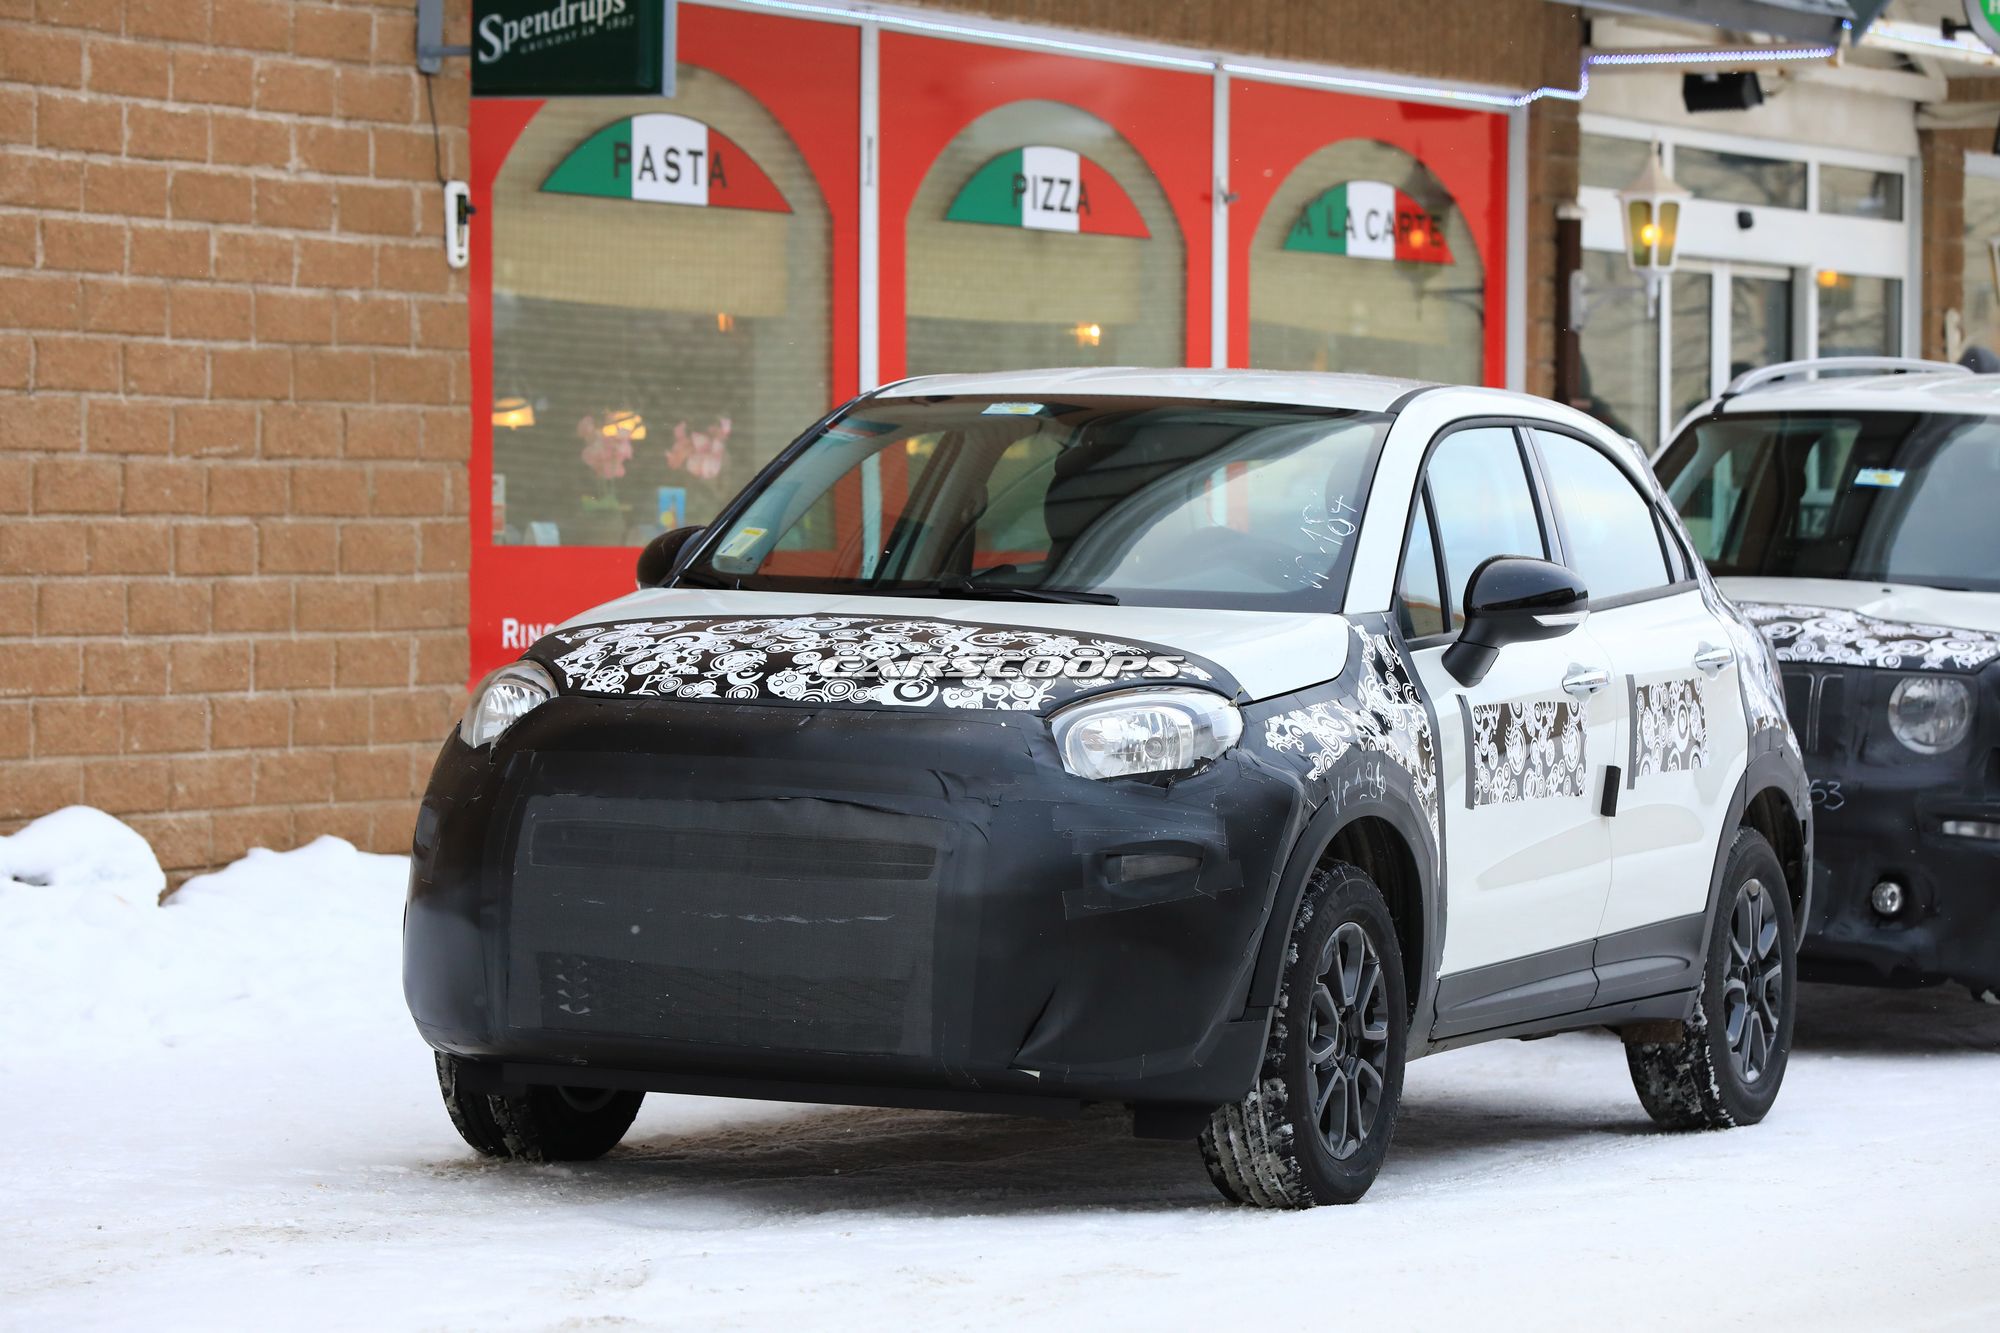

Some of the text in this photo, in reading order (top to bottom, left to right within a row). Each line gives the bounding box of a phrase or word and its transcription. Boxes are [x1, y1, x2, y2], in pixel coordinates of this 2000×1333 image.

[478, 0, 626, 64] Spendrups
[613, 142, 727, 188] PASTA
[1012, 172, 1091, 215] PIZZA
[1327, 205, 1357, 240] LA
[1364, 208, 1443, 248] CARTE
